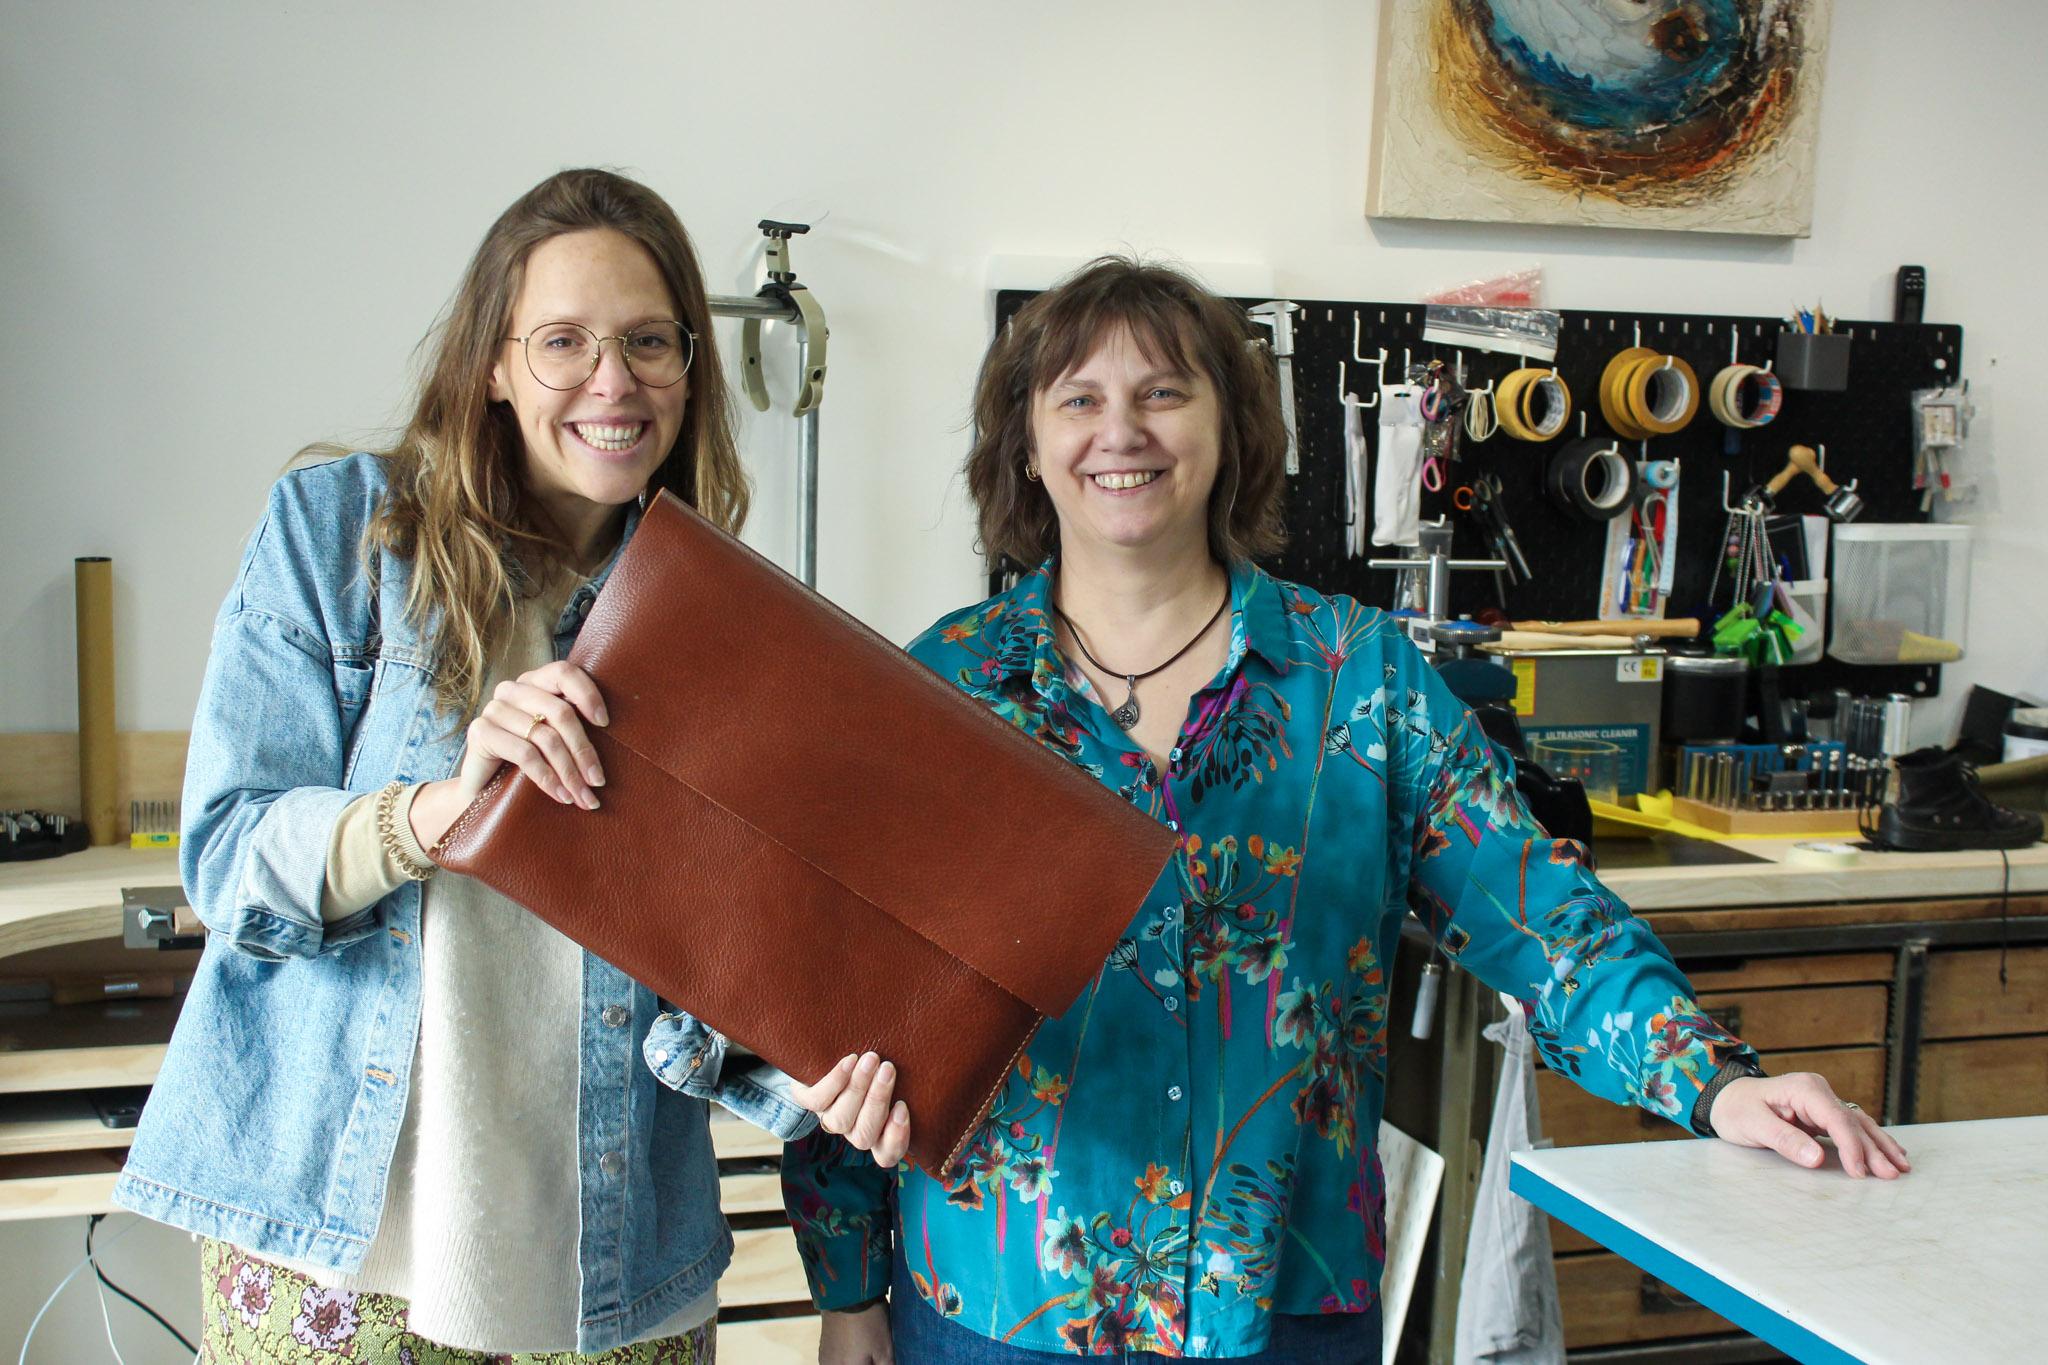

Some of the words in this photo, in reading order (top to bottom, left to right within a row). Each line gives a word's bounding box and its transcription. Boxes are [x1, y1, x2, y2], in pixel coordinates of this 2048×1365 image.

[1623, 661, 1637, 673] CE
[1545, 729, 1600, 741] ULTRASONIC
[1601, 728, 1638, 739] CLEANER
